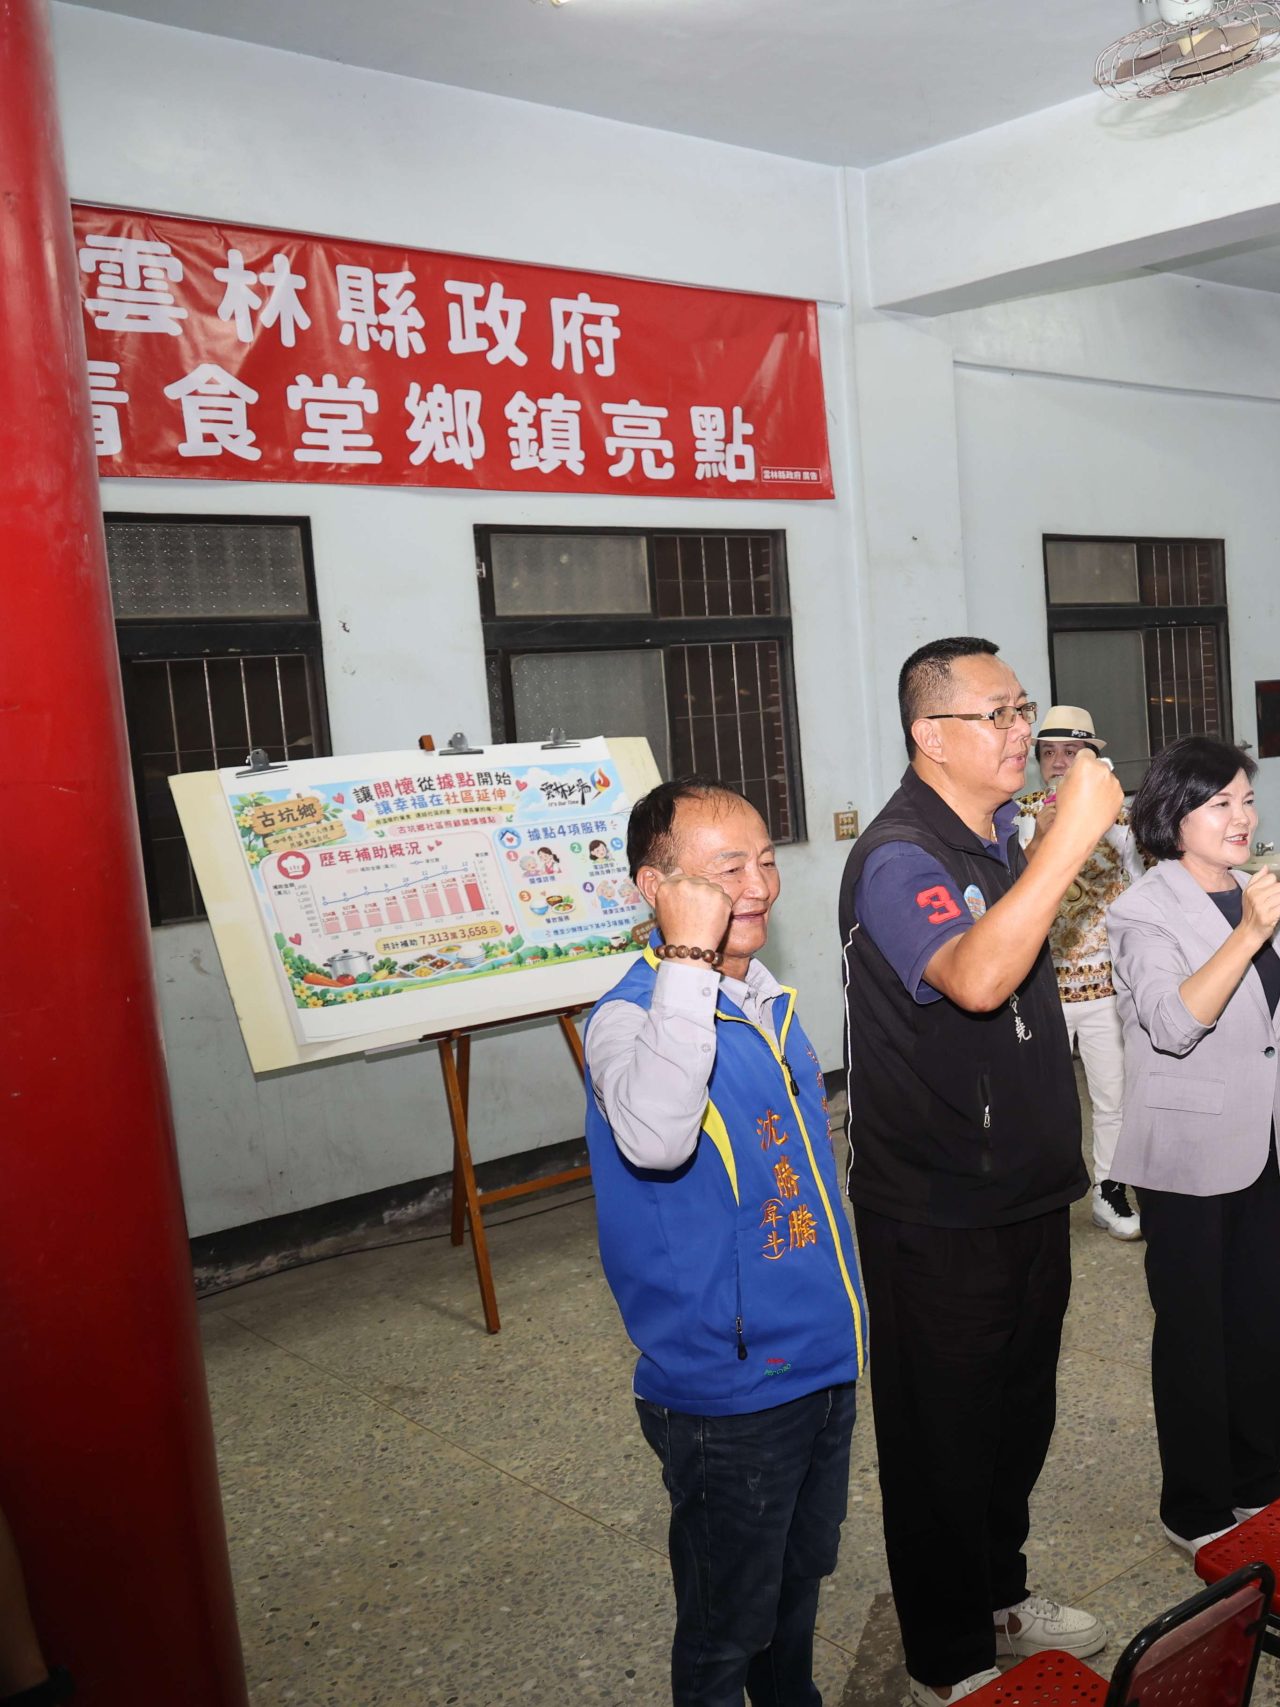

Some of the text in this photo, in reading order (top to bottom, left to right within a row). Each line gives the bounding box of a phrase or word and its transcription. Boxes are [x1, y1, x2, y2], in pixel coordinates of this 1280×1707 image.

[78, 234, 620, 376] 雲林縣政府
[352, 771, 512, 804] 讓關懷從據點開始
[375, 787, 507, 816] 讓幸福在社區延伸
[257, 803, 317, 828] 古坑鄉
[527, 820, 608, 841] 據點4項服務
[319, 841, 421, 867] 歷年補助概況
[916, 885, 962, 924] 3
